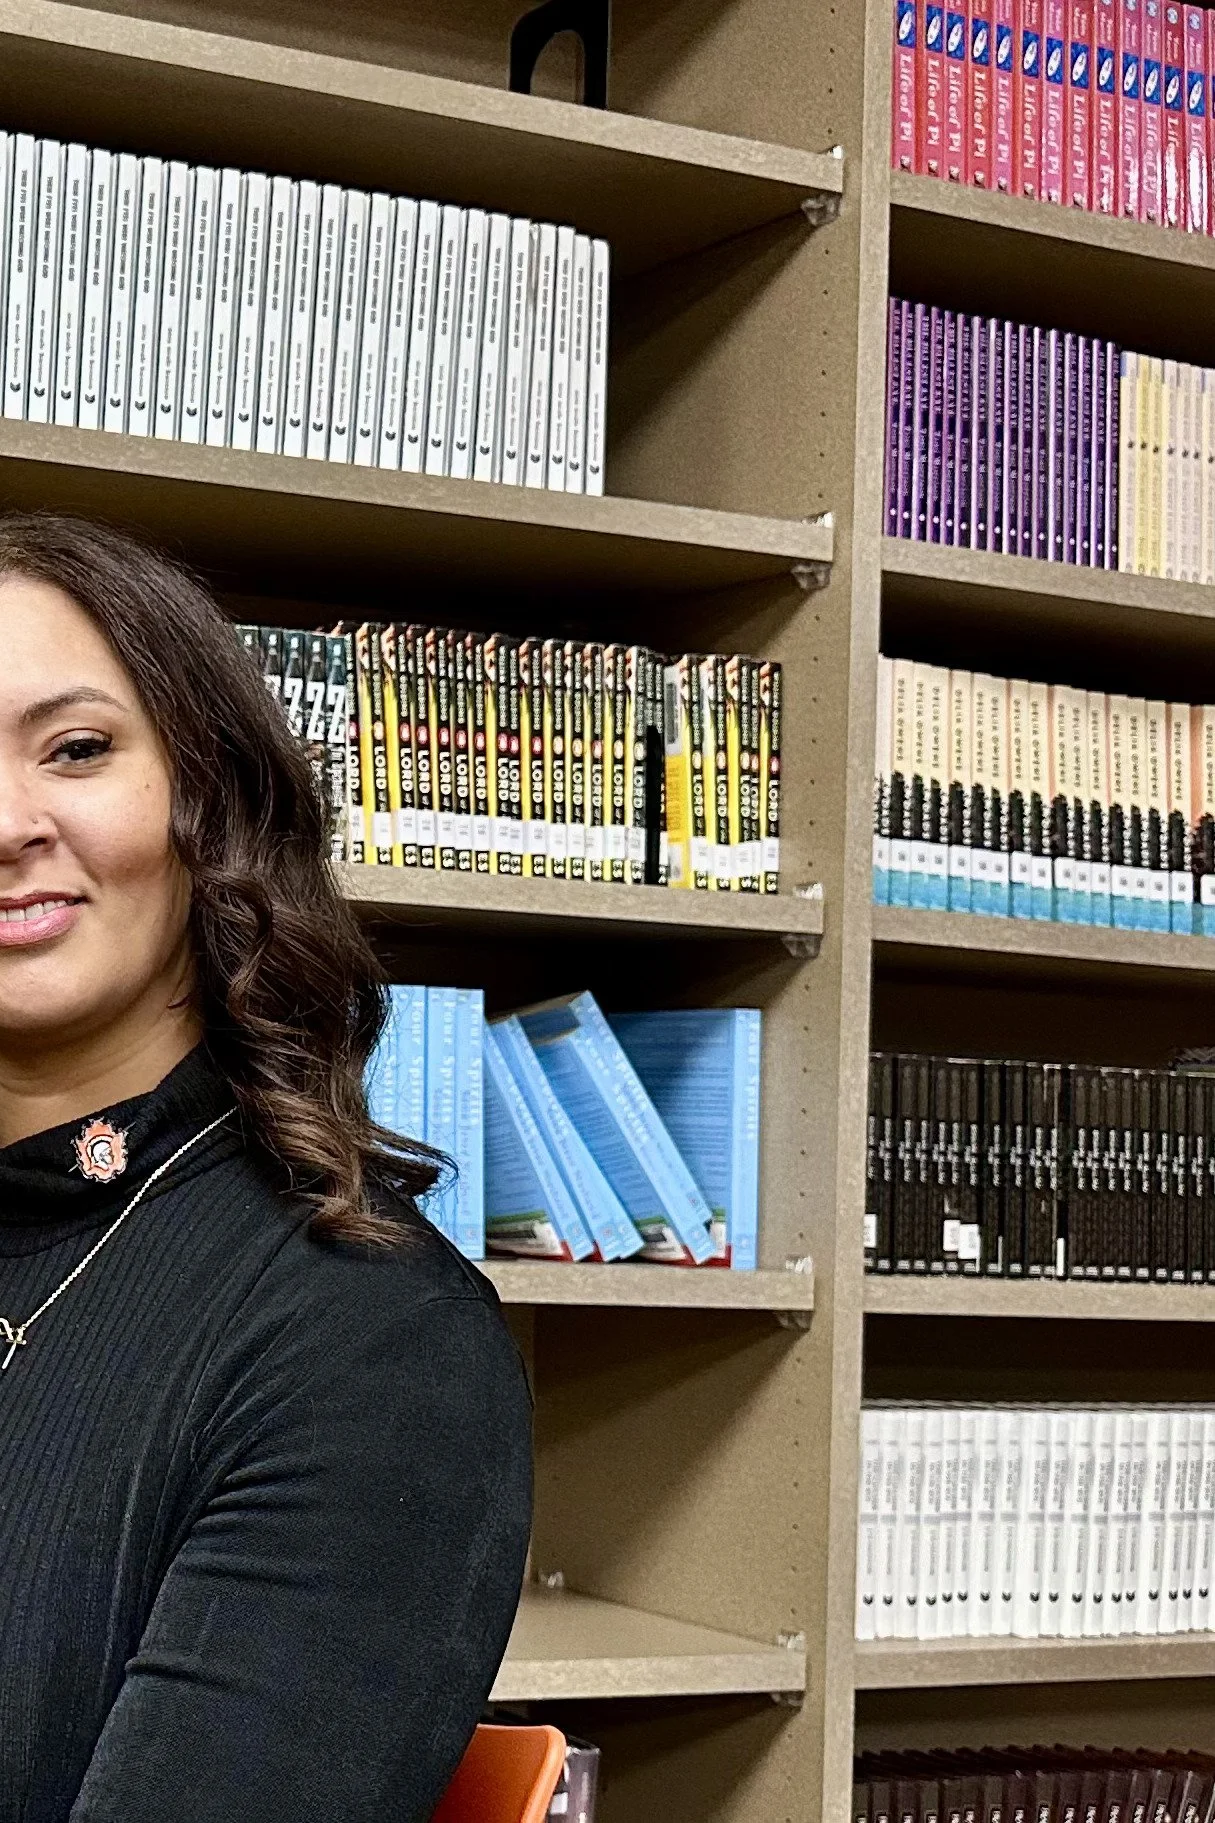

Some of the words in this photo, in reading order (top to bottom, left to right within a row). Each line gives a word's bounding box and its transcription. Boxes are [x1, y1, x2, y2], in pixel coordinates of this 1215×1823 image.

[375, 746, 387, 790] LORD
[400, 748, 413, 792] LORD
[418, 750, 430, 794] LORD
[440, 752, 452, 795] LORD
[476, 756, 487, 799] LORD
[532, 760, 543, 803] LORD
[553, 760, 564, 803] LORD
[693, 775, 704, 817] LORD
[717, 775, 727, 817] LORD
[768, 780, 778, 822] LORD
